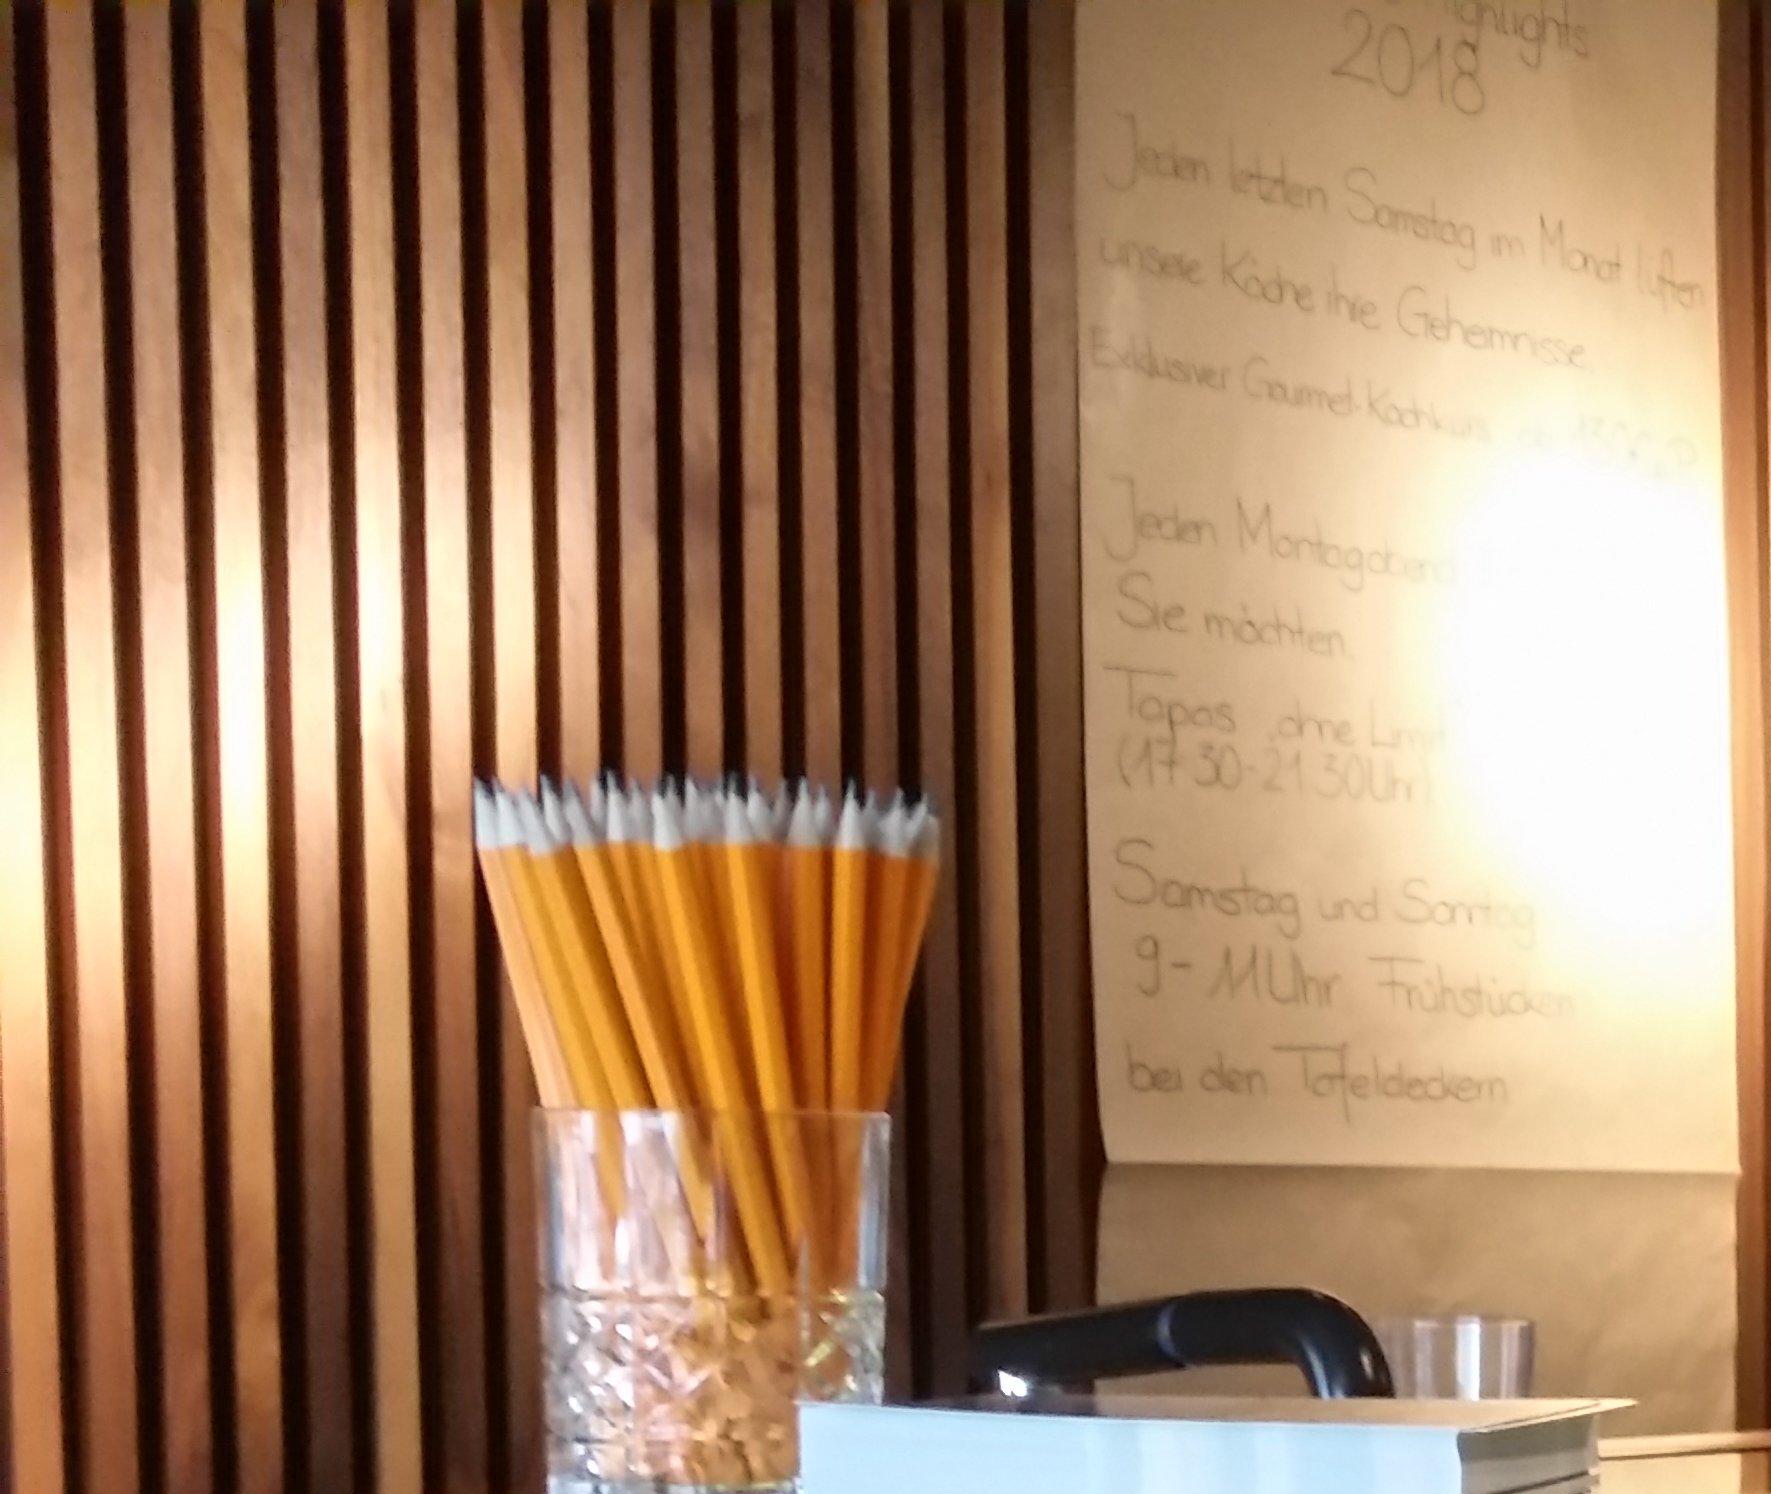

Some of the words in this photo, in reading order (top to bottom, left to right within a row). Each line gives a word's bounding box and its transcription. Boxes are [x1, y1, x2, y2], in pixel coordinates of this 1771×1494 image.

[1330, 8, 1486, 116] 2018
[1102, 110, 1210, 192] Jeden
[1344, 166, 1477, 272] Samstag
[1539, 212, 1622, 283] Monat
[1397, 285, 1587, 369] Geheimnisse
[1103, 474, 1218, 563] Jeden
[1116, 570, 1188, 633] Sie
[1102, 664, 1236, 748] Tapas
[1113, 836, 1300, 940] Samstag
[1320, 887, 1379, 922] und
[1125, 1037, 1183, 1095] bei
[1200, 1050, 1268, 1096] den
